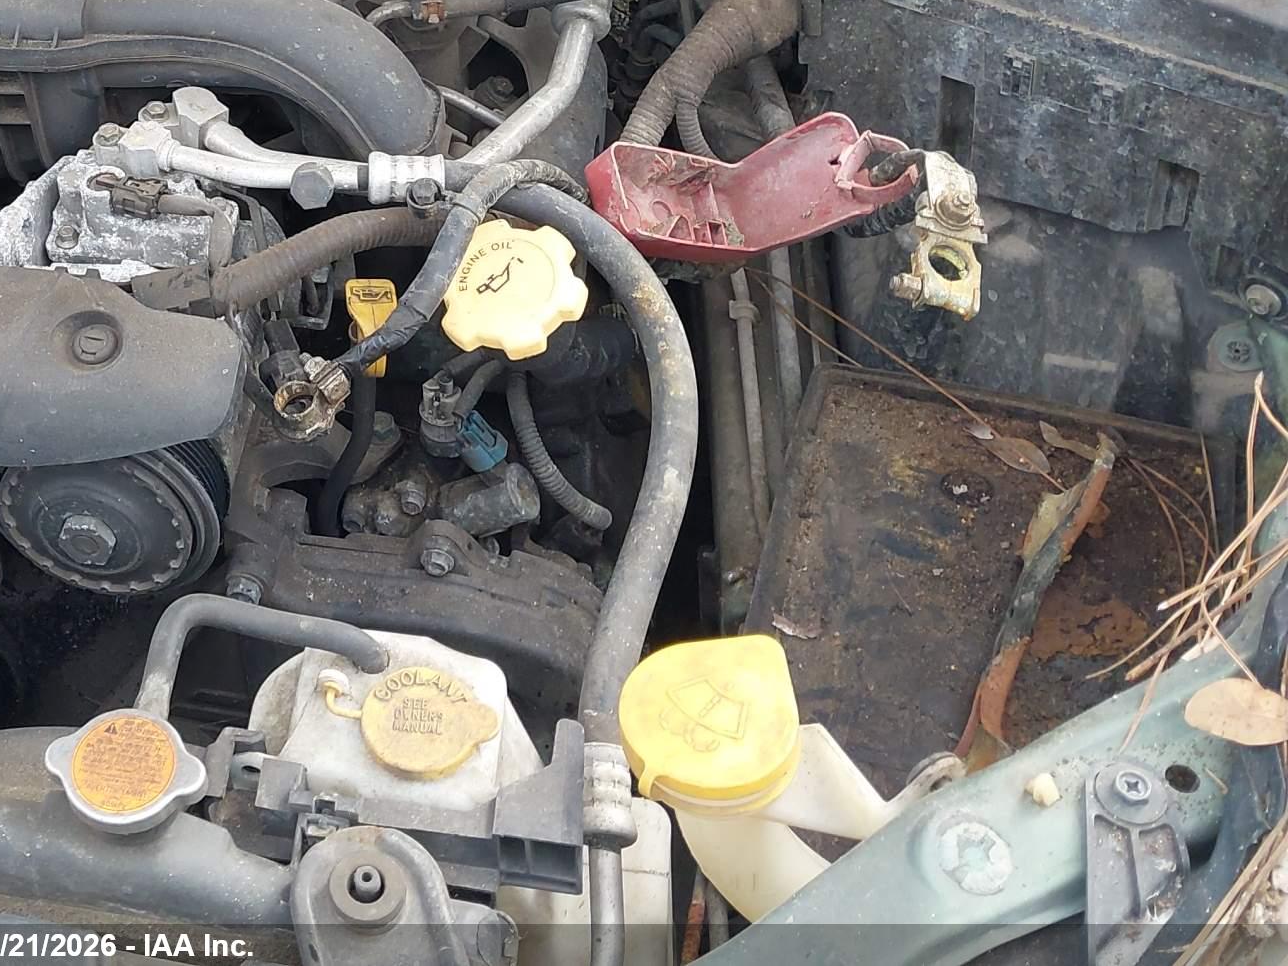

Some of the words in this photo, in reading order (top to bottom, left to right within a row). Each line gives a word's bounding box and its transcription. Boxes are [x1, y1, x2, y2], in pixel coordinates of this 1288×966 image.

[458, 249, 488, 292] ENGINE
[491, 241, 513, 251] OIL
[374, 669, 468, 704] COOLANT
[402, 698, 429, 709] SEE
[392, 721, 443, 736] MANUAL
